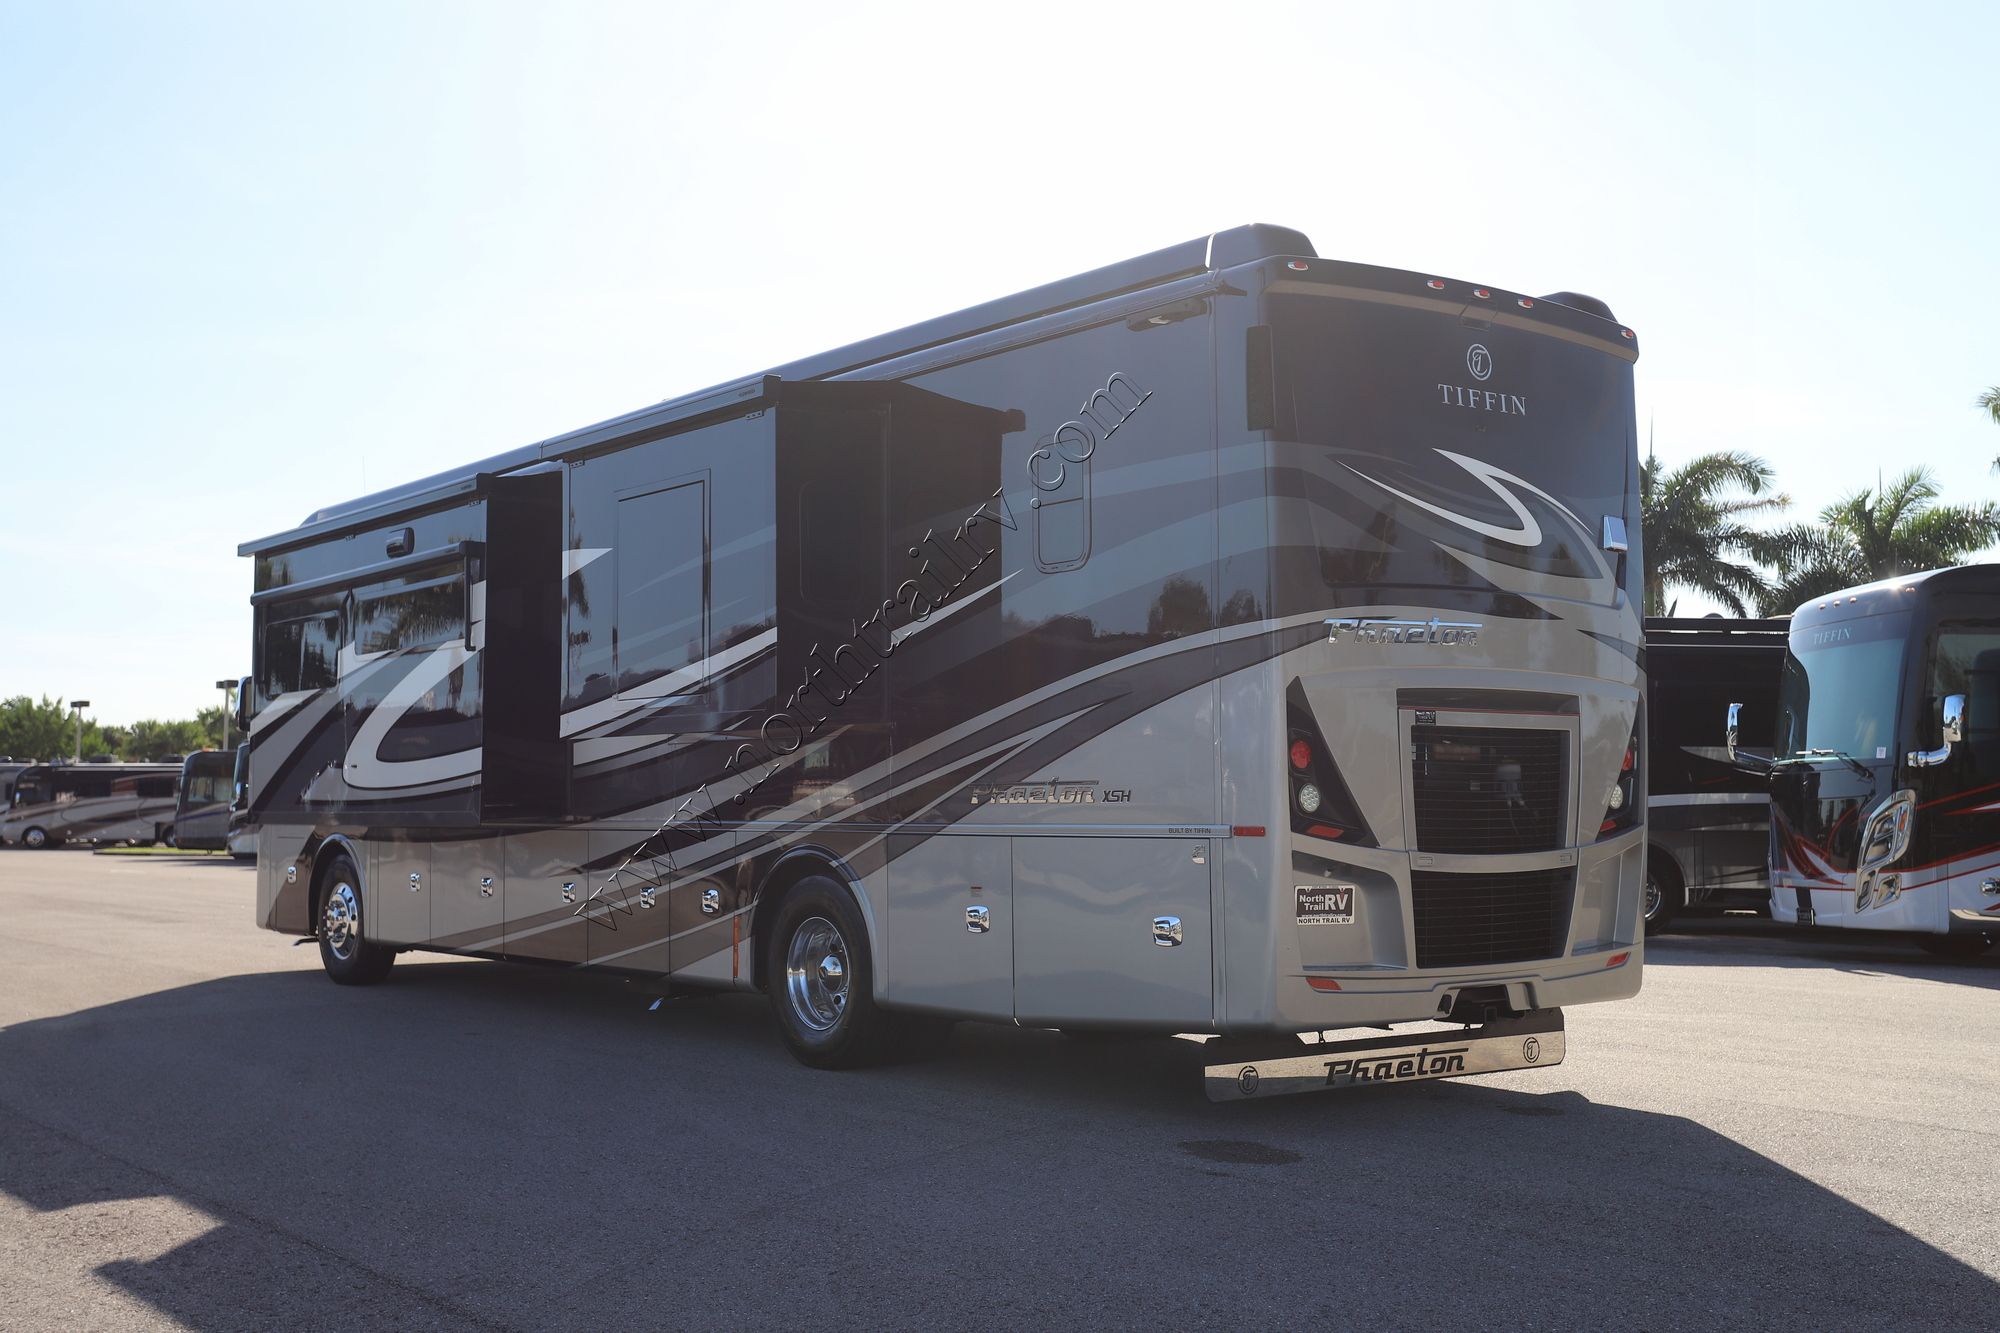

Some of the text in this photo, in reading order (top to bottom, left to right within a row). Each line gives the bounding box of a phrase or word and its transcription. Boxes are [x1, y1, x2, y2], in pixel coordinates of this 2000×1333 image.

[1437, 383, 1527, 416] TIFFIN
[1323, 616, 1483, 647] Phaeton
[1813, 627, 1852, 645] TIFFIN
[968, 776, 1131, 805] Phaeton XSH
[1299, 894, 1349, 911] North RV
[1304, 902, 1325, 911] Trail
[1323, 1047, 1470, 1086] Phaeton
